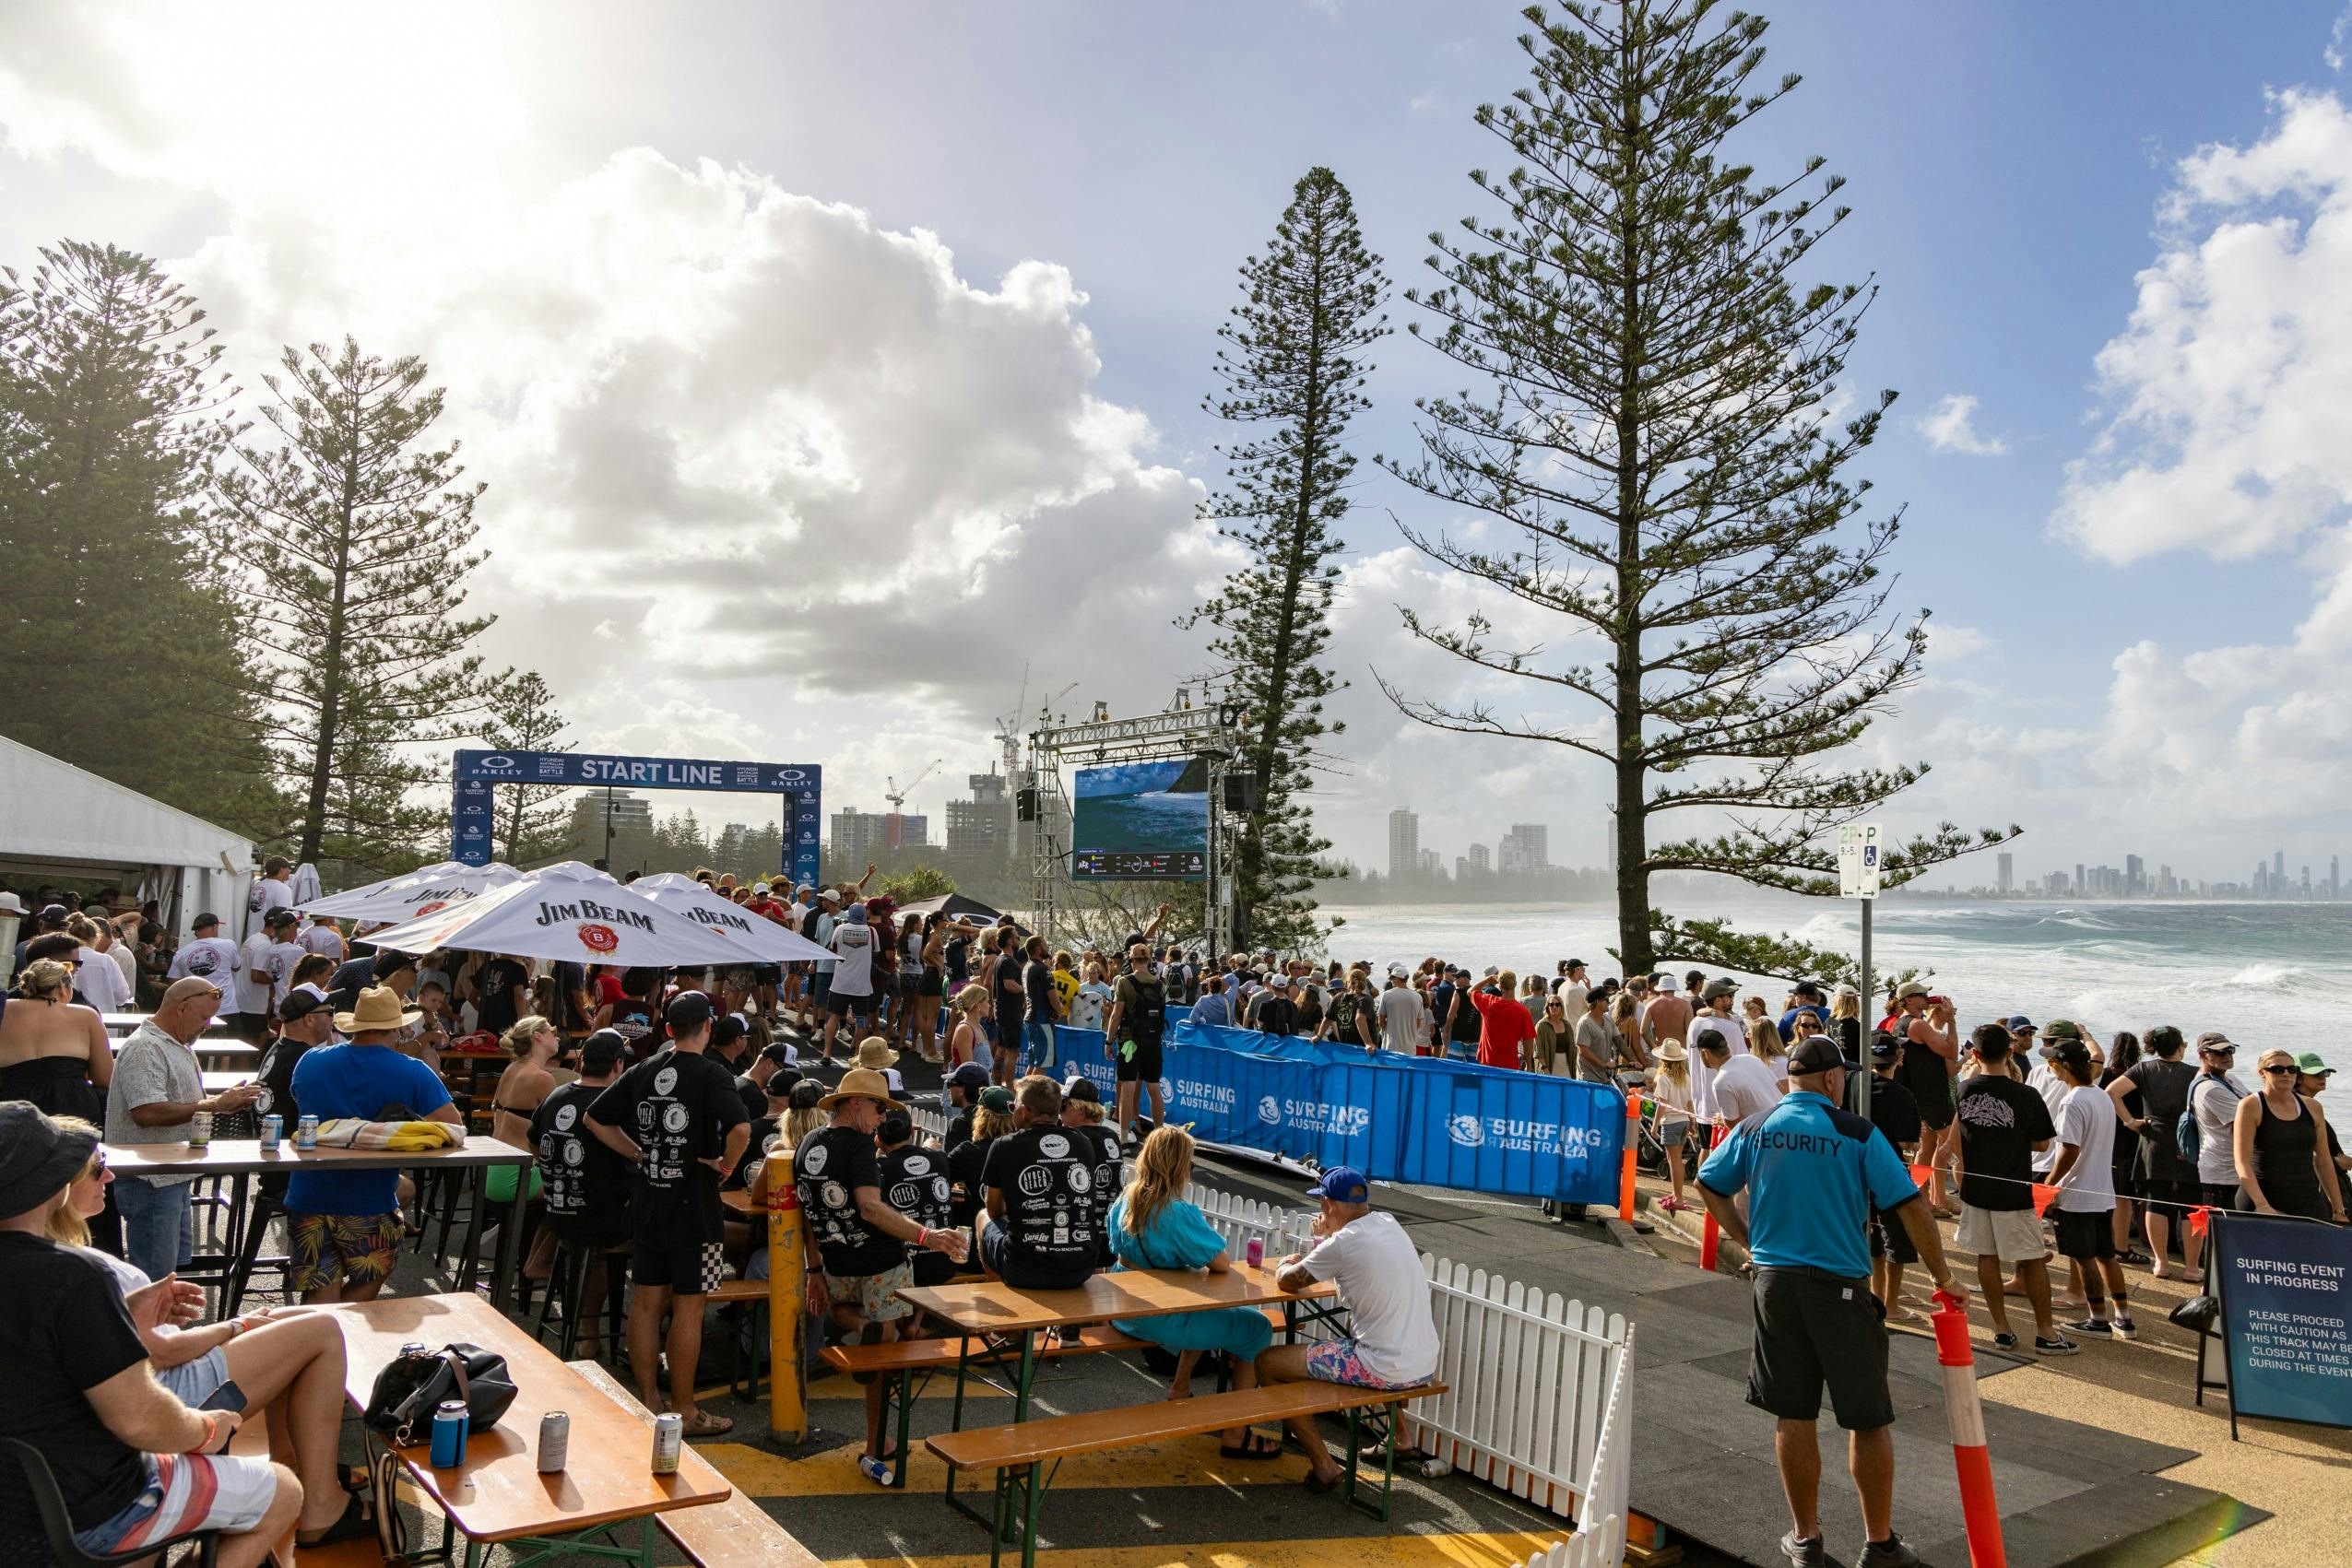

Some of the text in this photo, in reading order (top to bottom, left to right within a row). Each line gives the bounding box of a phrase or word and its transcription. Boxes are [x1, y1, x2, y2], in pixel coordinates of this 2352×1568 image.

[581, 760, 723, 784] START LINE
[1866, 826, 1876, 843] P
[536, 899, 656, 935] JIM BEAM
[692, 906, 754, 935] BEAM
[612, 1022, 632, 1031] NORTH
[1176, 1079, 1235, 1103] SURFING
[1180, 1096, 1230, 1114] AUSTRALIA
[1284, 1098, 1369, 1125] SURFING
[1288, 1116, 1358, 1137] AUSTRALIA
[1493, 1118, 1601, 1147] SURFING
[1499, 1137, 1589, 1159] AUSTRALIA
[2236, 1257, 2346, 1279] SURFING EVENT
[2246, 1273, 2339, 1291] IN PROGRESS
[2249, 1310, 2345, 1327] PLEASE PROCEED
[2250, 1322, 2347, 1340] WITH CAUTION AS
[2244, 1333, 2352, 1353] THIS TRACK MAY BE
[2252, 1346, 2349, 1364] CLOSED AT TIMES
[2249, 1357, 2352, 1378] DURING THE EVENT
